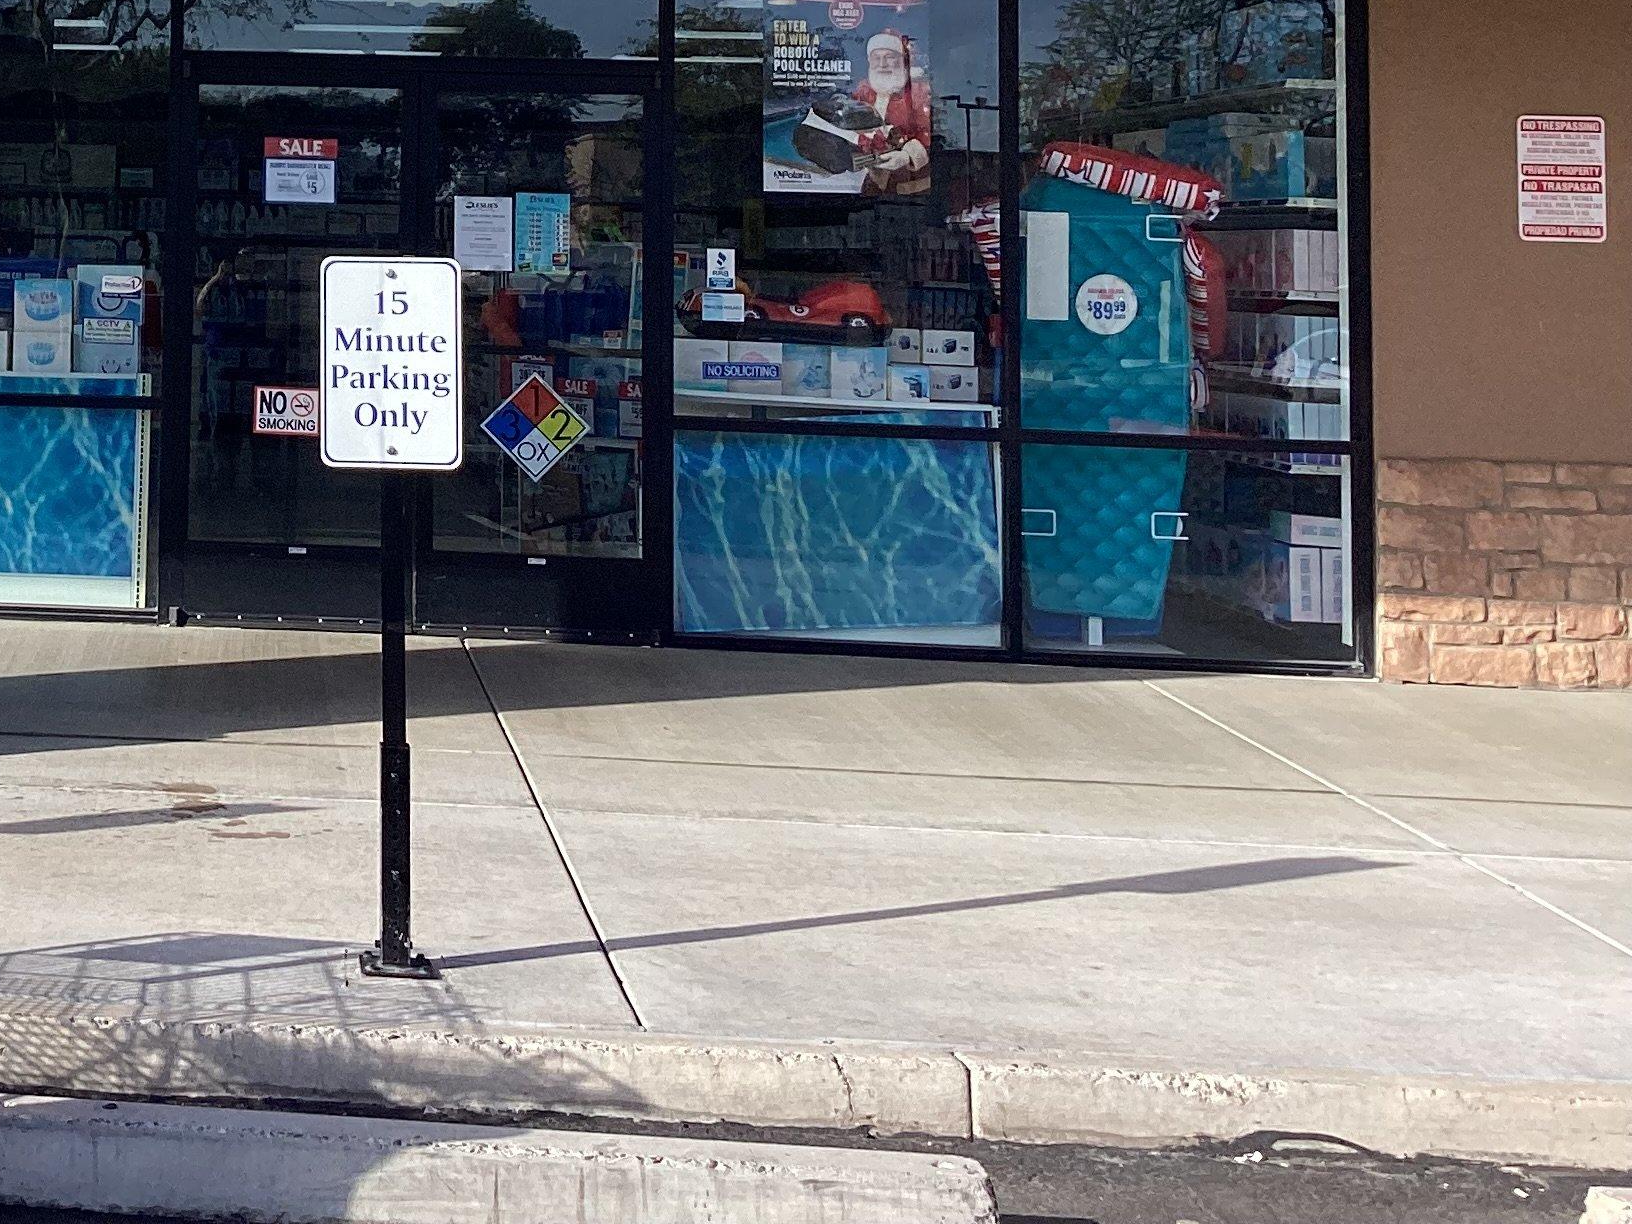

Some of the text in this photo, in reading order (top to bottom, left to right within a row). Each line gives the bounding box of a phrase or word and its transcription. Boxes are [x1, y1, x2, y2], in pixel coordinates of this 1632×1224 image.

[773, 19, 807, 32] ENTER
[774, 33, 820, 46] TO WIN A
[773, 46, 819, 59] ROBOTIC
[773, 59, 852, 72] POOL CLEANER
[1522, 121, 1600, 131] NO TRESPASSING
[279, 138, 323, 156] SALE
[1523, 165, 1600, 176] PRIVATE PROPERTY
[1523, 181, 1600, 193] NO TRASPASAR
[374, 291, 410, 316] 15
[96, 319, 120, 327] CCTV
[334, 327, 447, 354] Minute
[707, 365, 777, 378] NO SOLICITING
[331, 364, 451, 397] Parking
[564, 379, 589, 394] SALE
[260, 391, 287, 415] NO
[530, 384, 540, 417] 1
[259, 417, 316, 432] SMOKING
[354, 402, 428, 434] Only
[501, 409, 518, 441] 3
[550, 408, 572, 441] 2
[517, 441, 550, 462] OX
